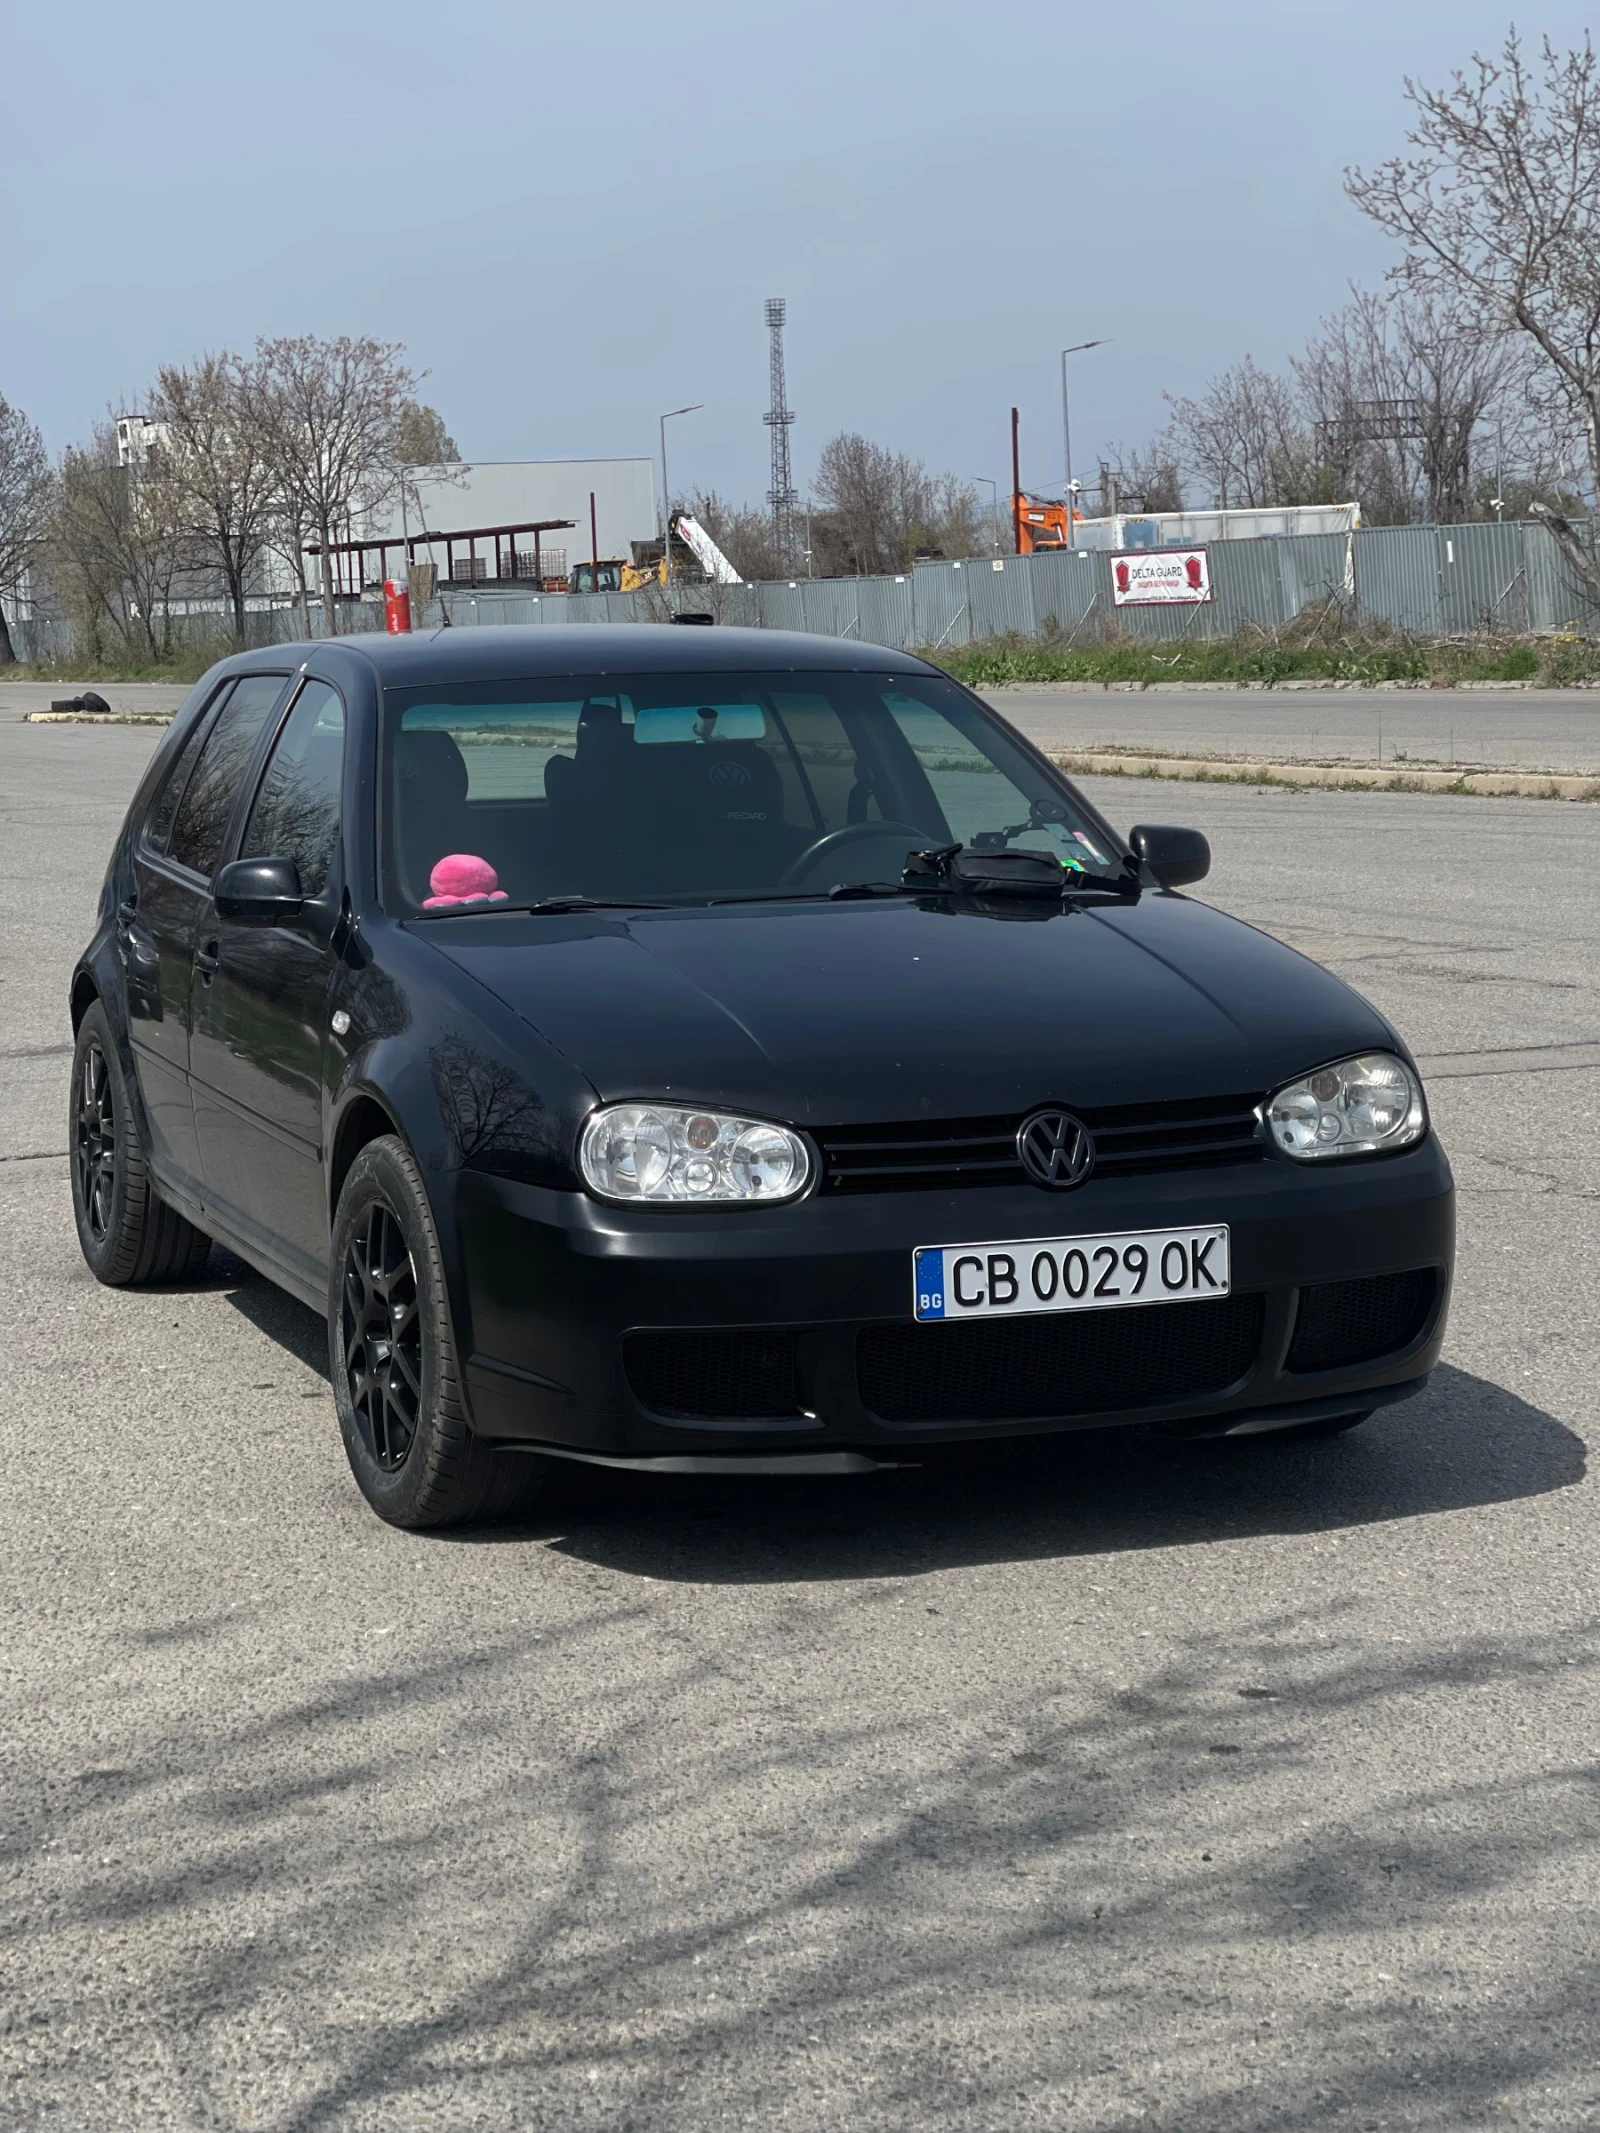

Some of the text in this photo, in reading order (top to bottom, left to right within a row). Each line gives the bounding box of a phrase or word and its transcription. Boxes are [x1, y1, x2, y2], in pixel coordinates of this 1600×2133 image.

[1132, 566, 1183, 579] DELTA GUARD
[727, 811, 767, 820] RECARO
[1020, 1112, 1091, 1184] VW
[953, 1236, 1218, 1307] CB 0029 OK
[920, 1294, 942, 1309] BG
